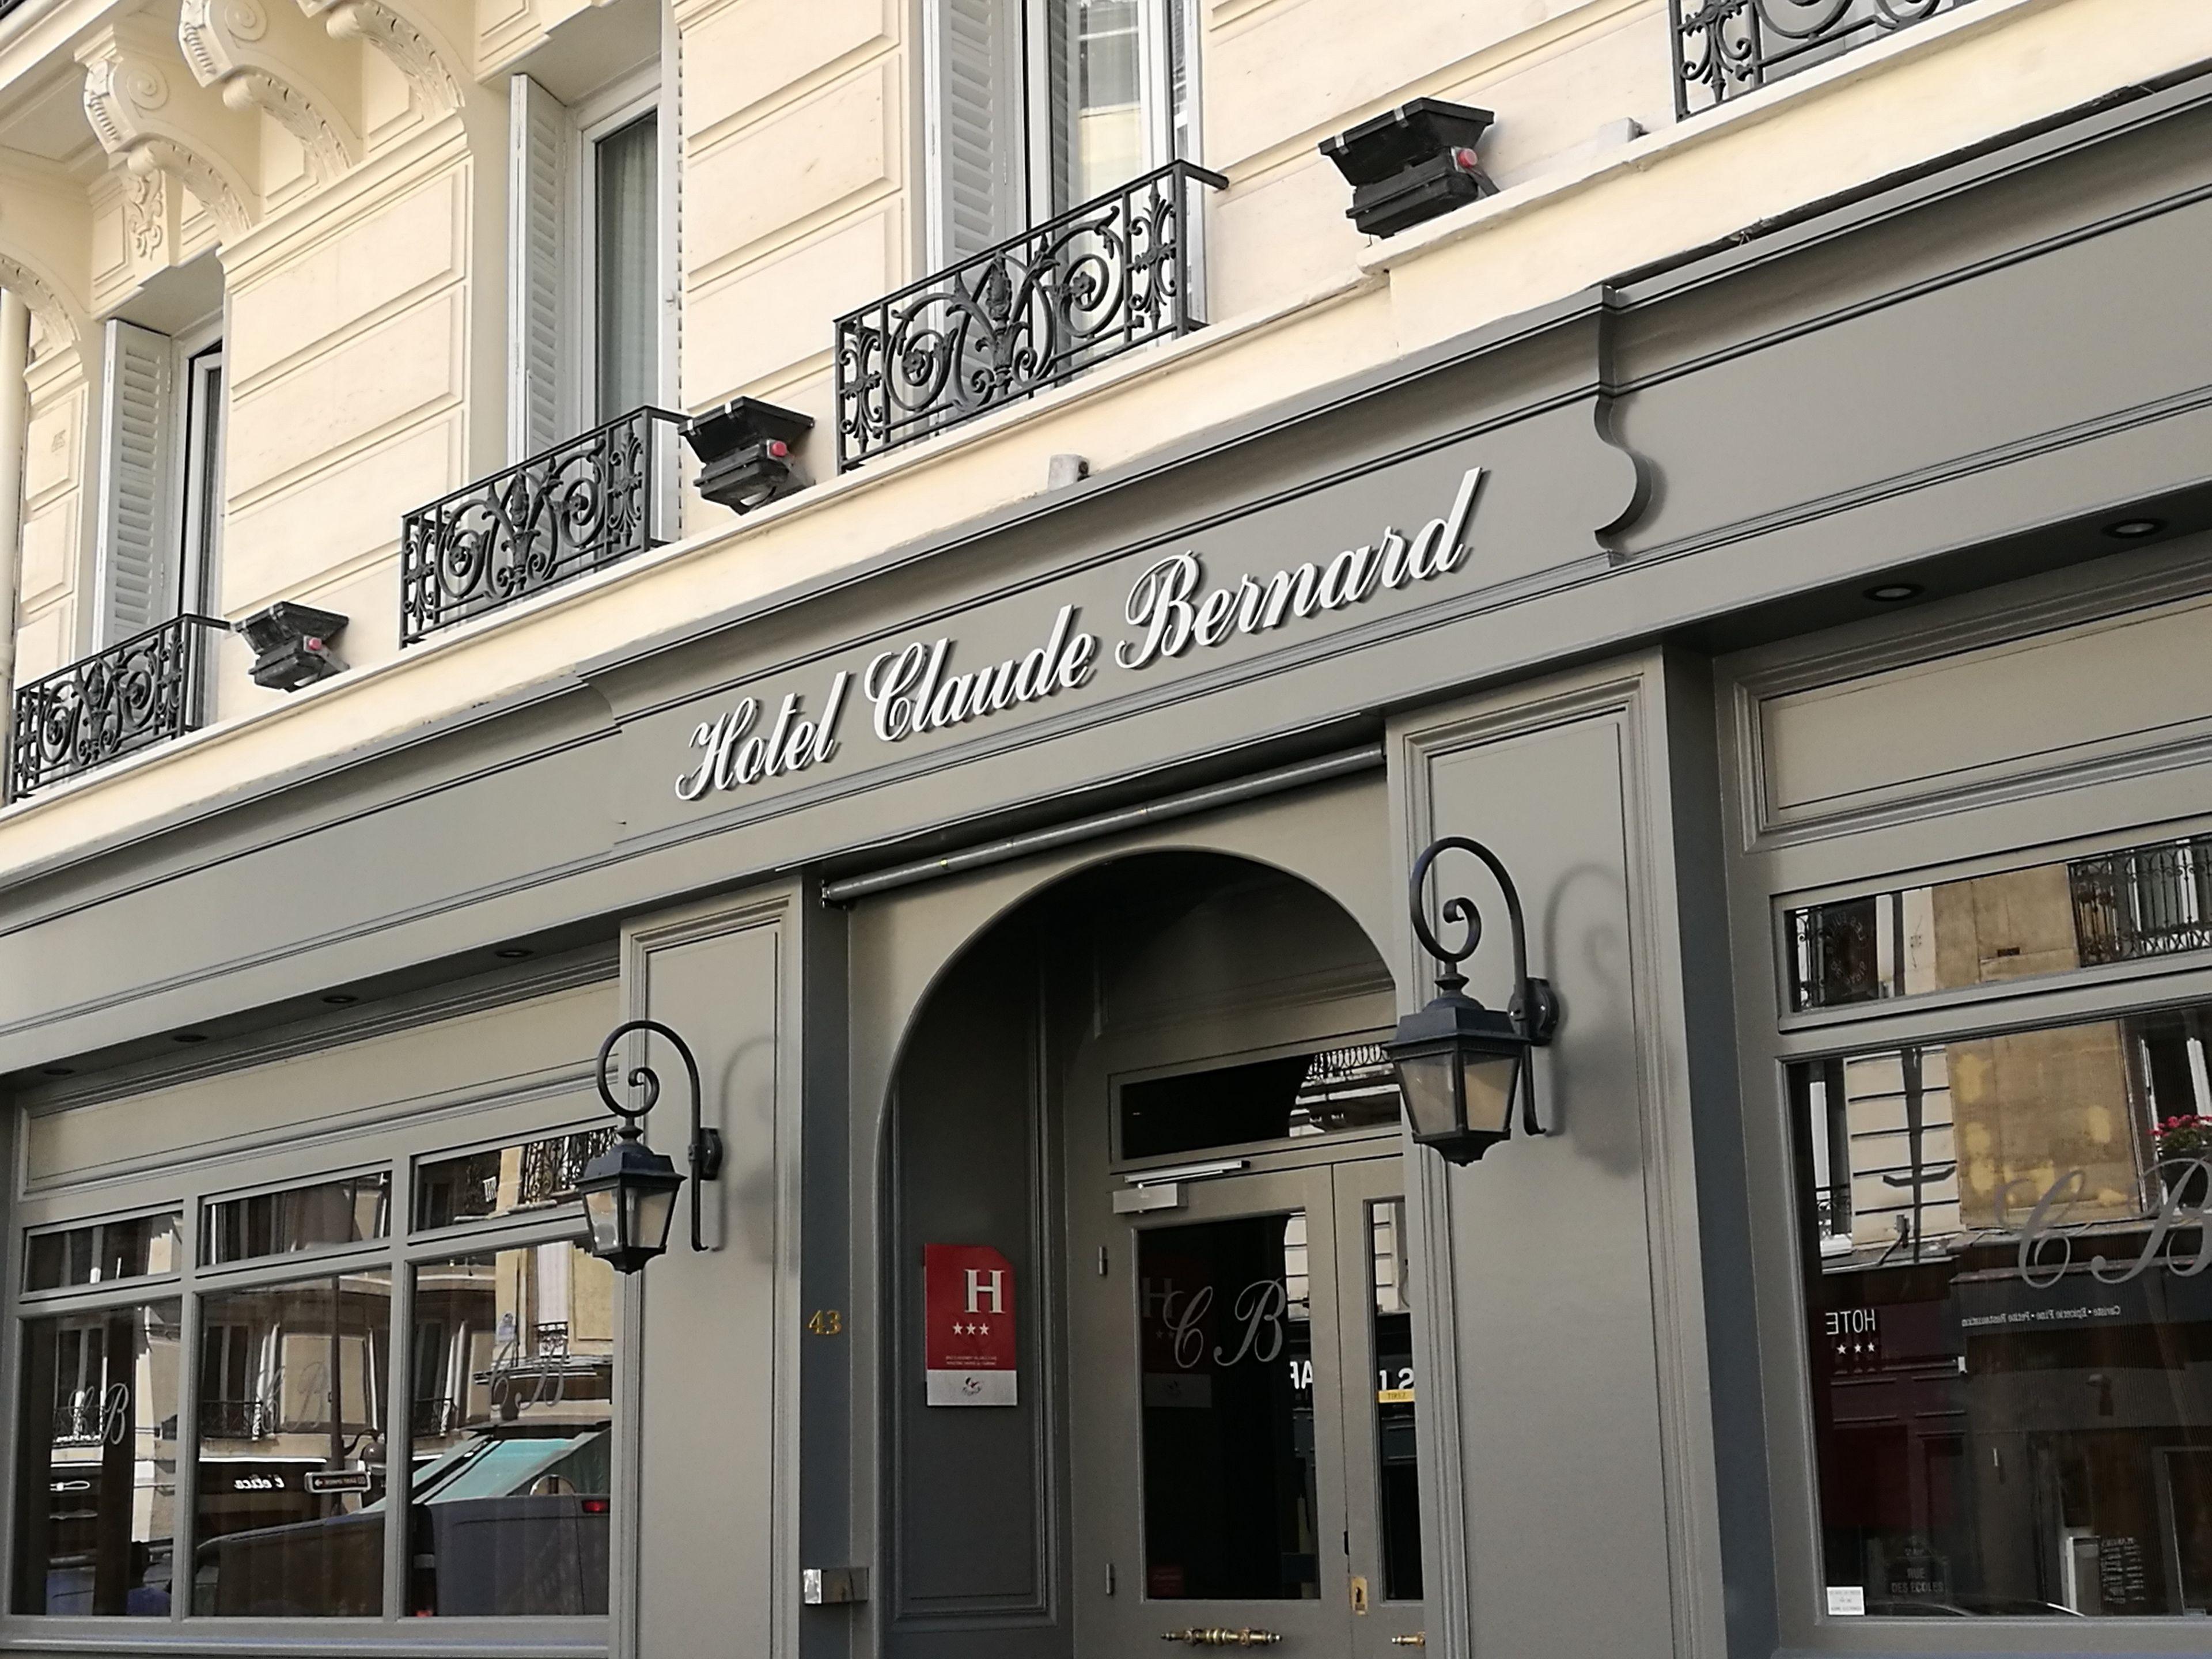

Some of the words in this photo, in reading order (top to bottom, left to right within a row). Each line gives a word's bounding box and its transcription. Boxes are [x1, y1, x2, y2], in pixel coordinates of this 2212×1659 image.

[675, 671, 849, 800] Hotel
[864, 616, 1094, 741] Claude
[1115, 467, 1482, 669] Bernard
[965, 1269, 1005, 1313] H
[808, 1310, 842, 1335] 43
